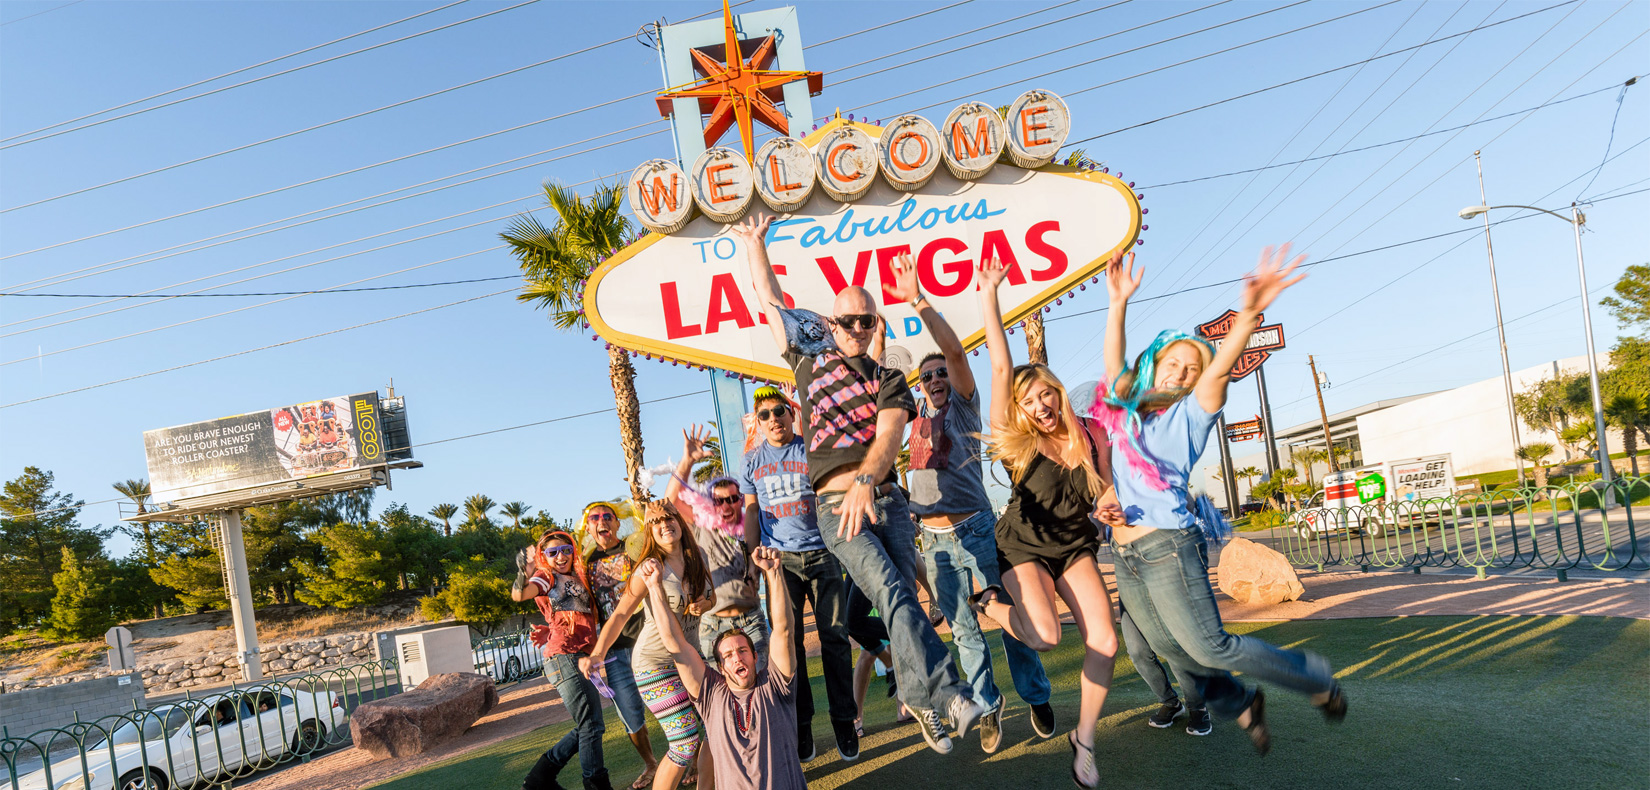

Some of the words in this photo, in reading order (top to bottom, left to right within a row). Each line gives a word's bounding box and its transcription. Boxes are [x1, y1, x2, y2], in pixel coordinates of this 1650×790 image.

[636, 105, 1053, 217] WELCOME
[692, 237, 736, 263] TO
[764, 198, 1007, 249] Fabulous
[815, 220, 1069, 306] VEGAS
[354, 399, 373, 409] EL
[278, 419, 290, 428] NEW
[155, 437, 173, 448] ARE
[172, 434, 192, 444] YOU
[194, 428, 221, 441] BRAVE
[222, 421, 261, 435] ENOUGH
[163, 447, 176, 457] TO
[177, 443, 199, 454] RIDE
[199, 440, 219, 450] OUR
[220, 433, 255, 446] NEWEST
[172, 452, 205, 465] ROLLER
[206, 444, 249, 459] COASTER?
[753, 461, 779, 482] NEW
[1399, 470, 1445, 483] LOADING
[1425, 461, 1445, 471] GET
[1415, 479, 1446, 490] HELP!
[765, 500, 810, 519] GIANTS
